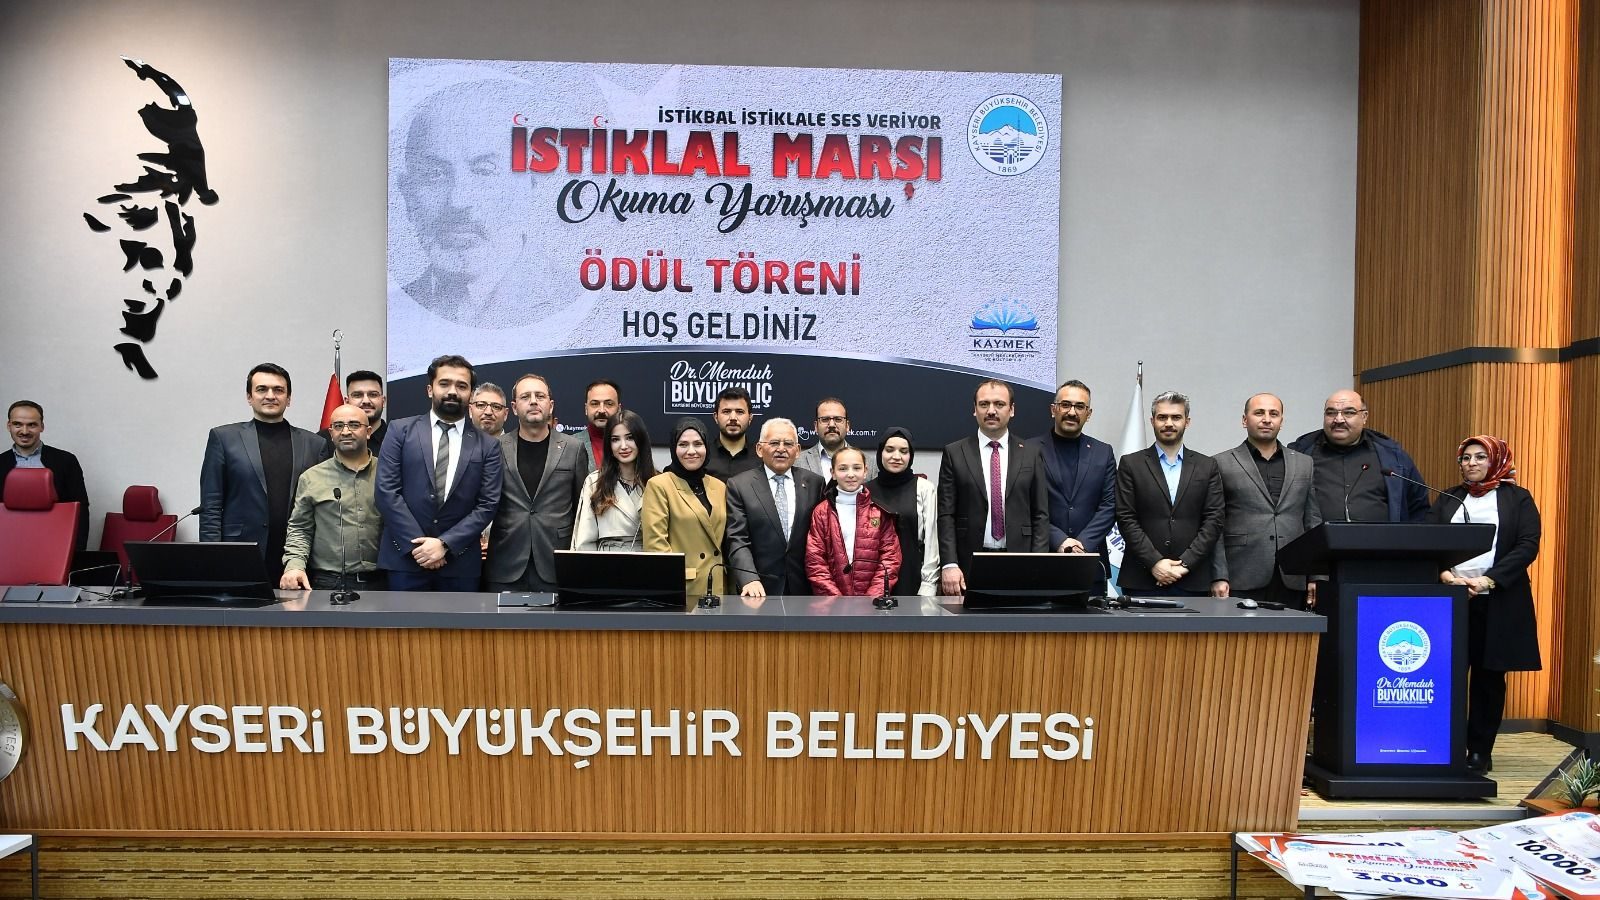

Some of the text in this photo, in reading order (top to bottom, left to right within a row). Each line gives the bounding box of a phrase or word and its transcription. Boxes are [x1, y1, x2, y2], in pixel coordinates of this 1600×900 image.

[659, 106, 941, 130] İSTİKBAL İSTİKLALE SES VERİYOR
[511, 114, 943, 201] İSTİKLAL MARŞI
[556, 178, 895, 234] Okuma Yarışması
[579, 248, 861, 296] ÖDÜL TÖRENİ
[622, 306, 818, 342] HOŞ GELDİNİZ
[973, 338, 1034, 349] KAYMEK
[670, 360, 774, 381] Dr. Memduh
[1392, 677, 1435, 689] Memduh
[1515, 839, 1592, 876] 10.000
[1352, 871, 1449, 887] 3.000
